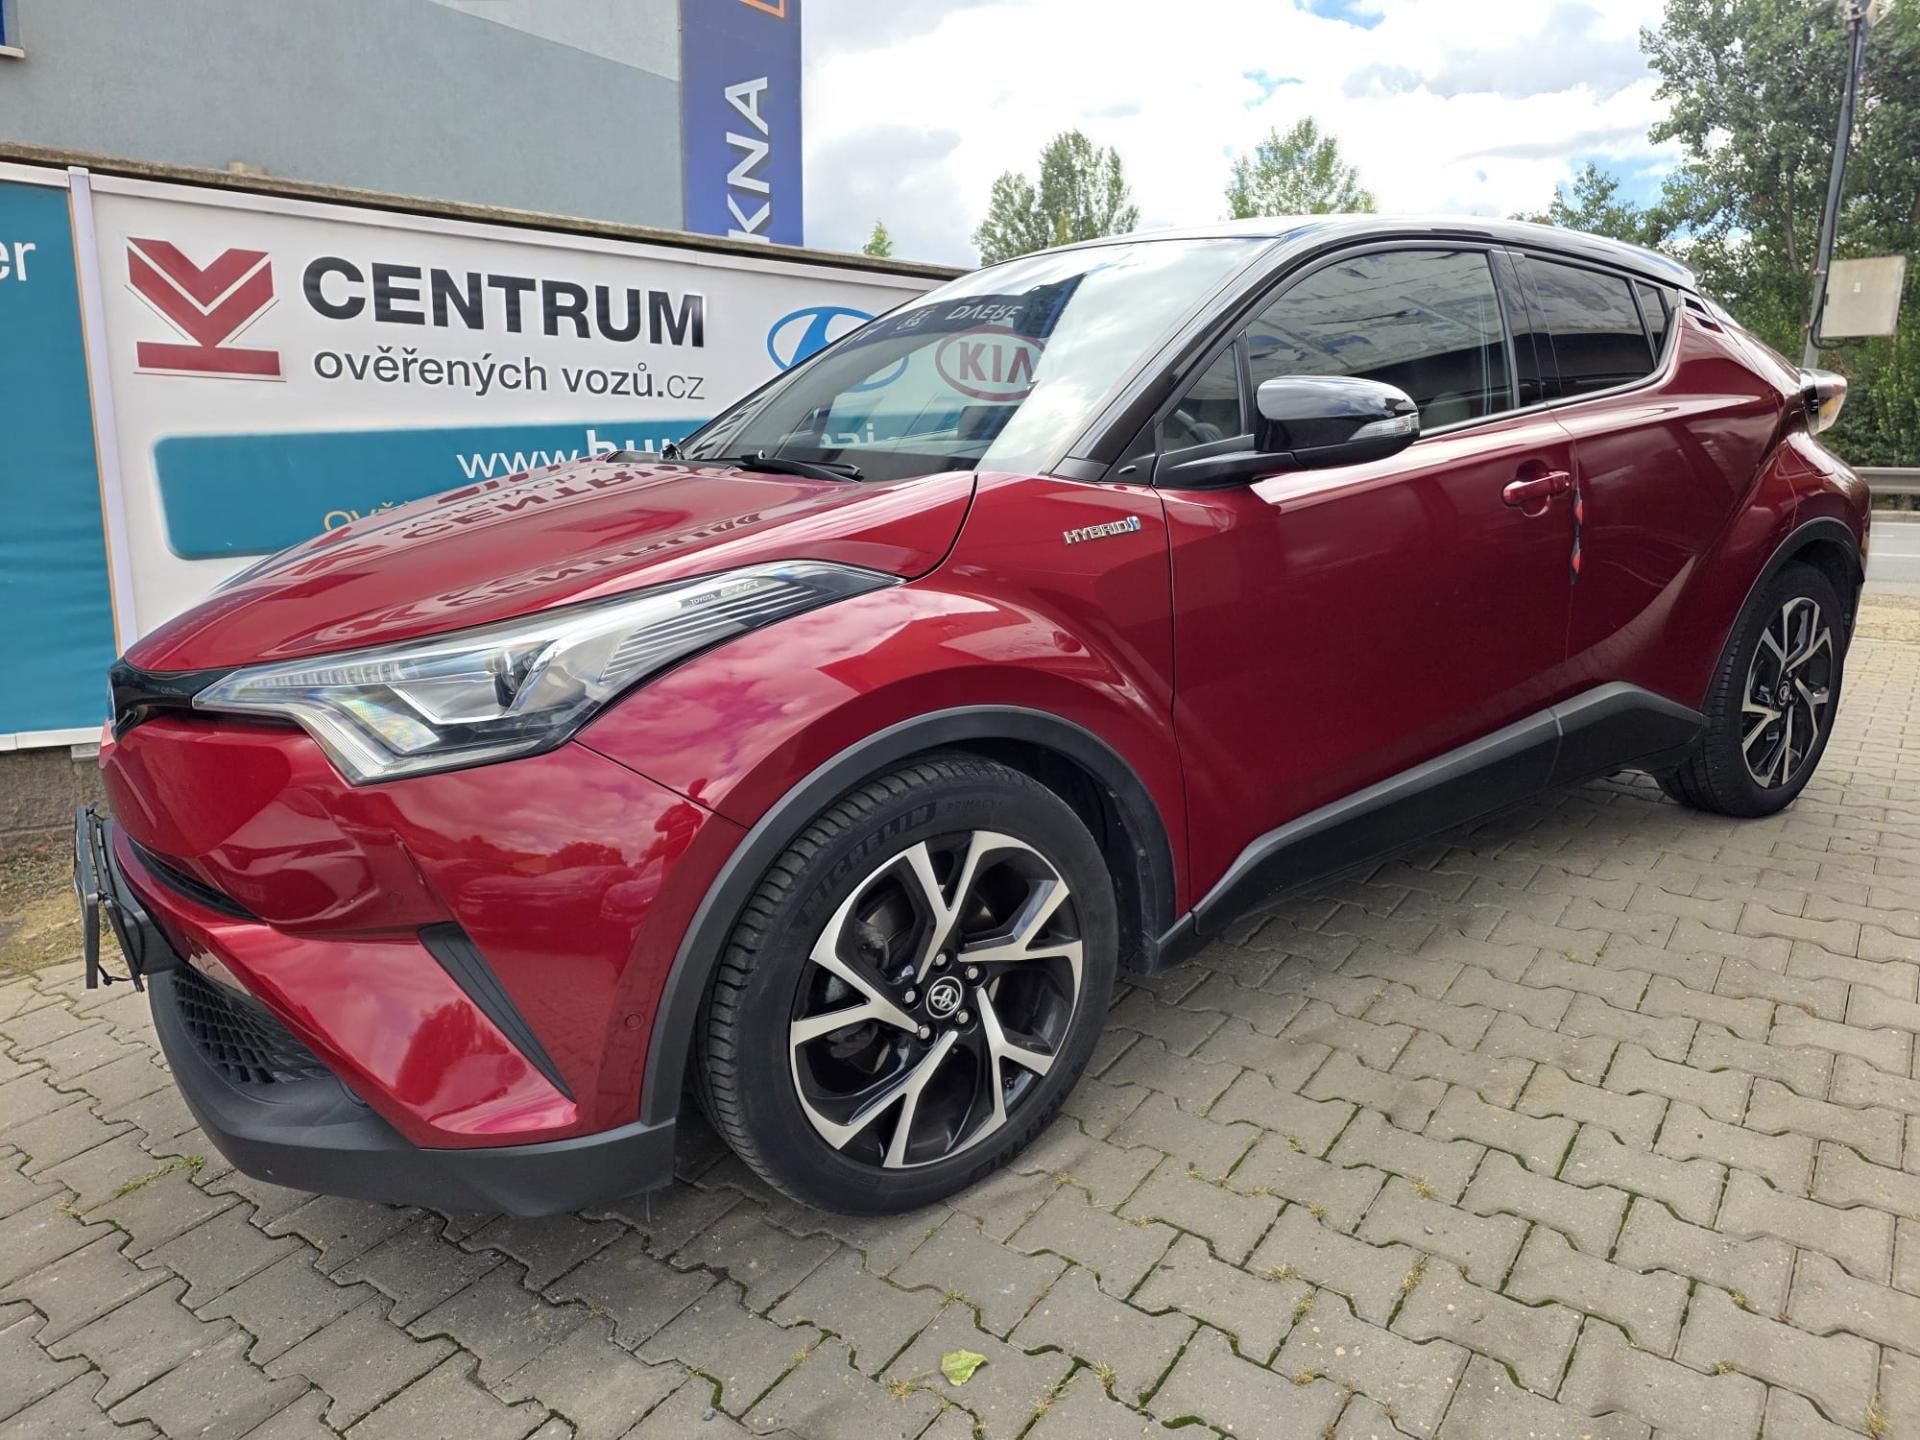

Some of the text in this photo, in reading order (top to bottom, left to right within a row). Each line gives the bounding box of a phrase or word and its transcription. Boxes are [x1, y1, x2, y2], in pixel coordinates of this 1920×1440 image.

[302, 256, 705, 348] CENTRUM
[313, 345, 548, 397] ověřených
[958, 341, 1036, 384] KIA
[1063, 519, 1128, 544] HYBRID
